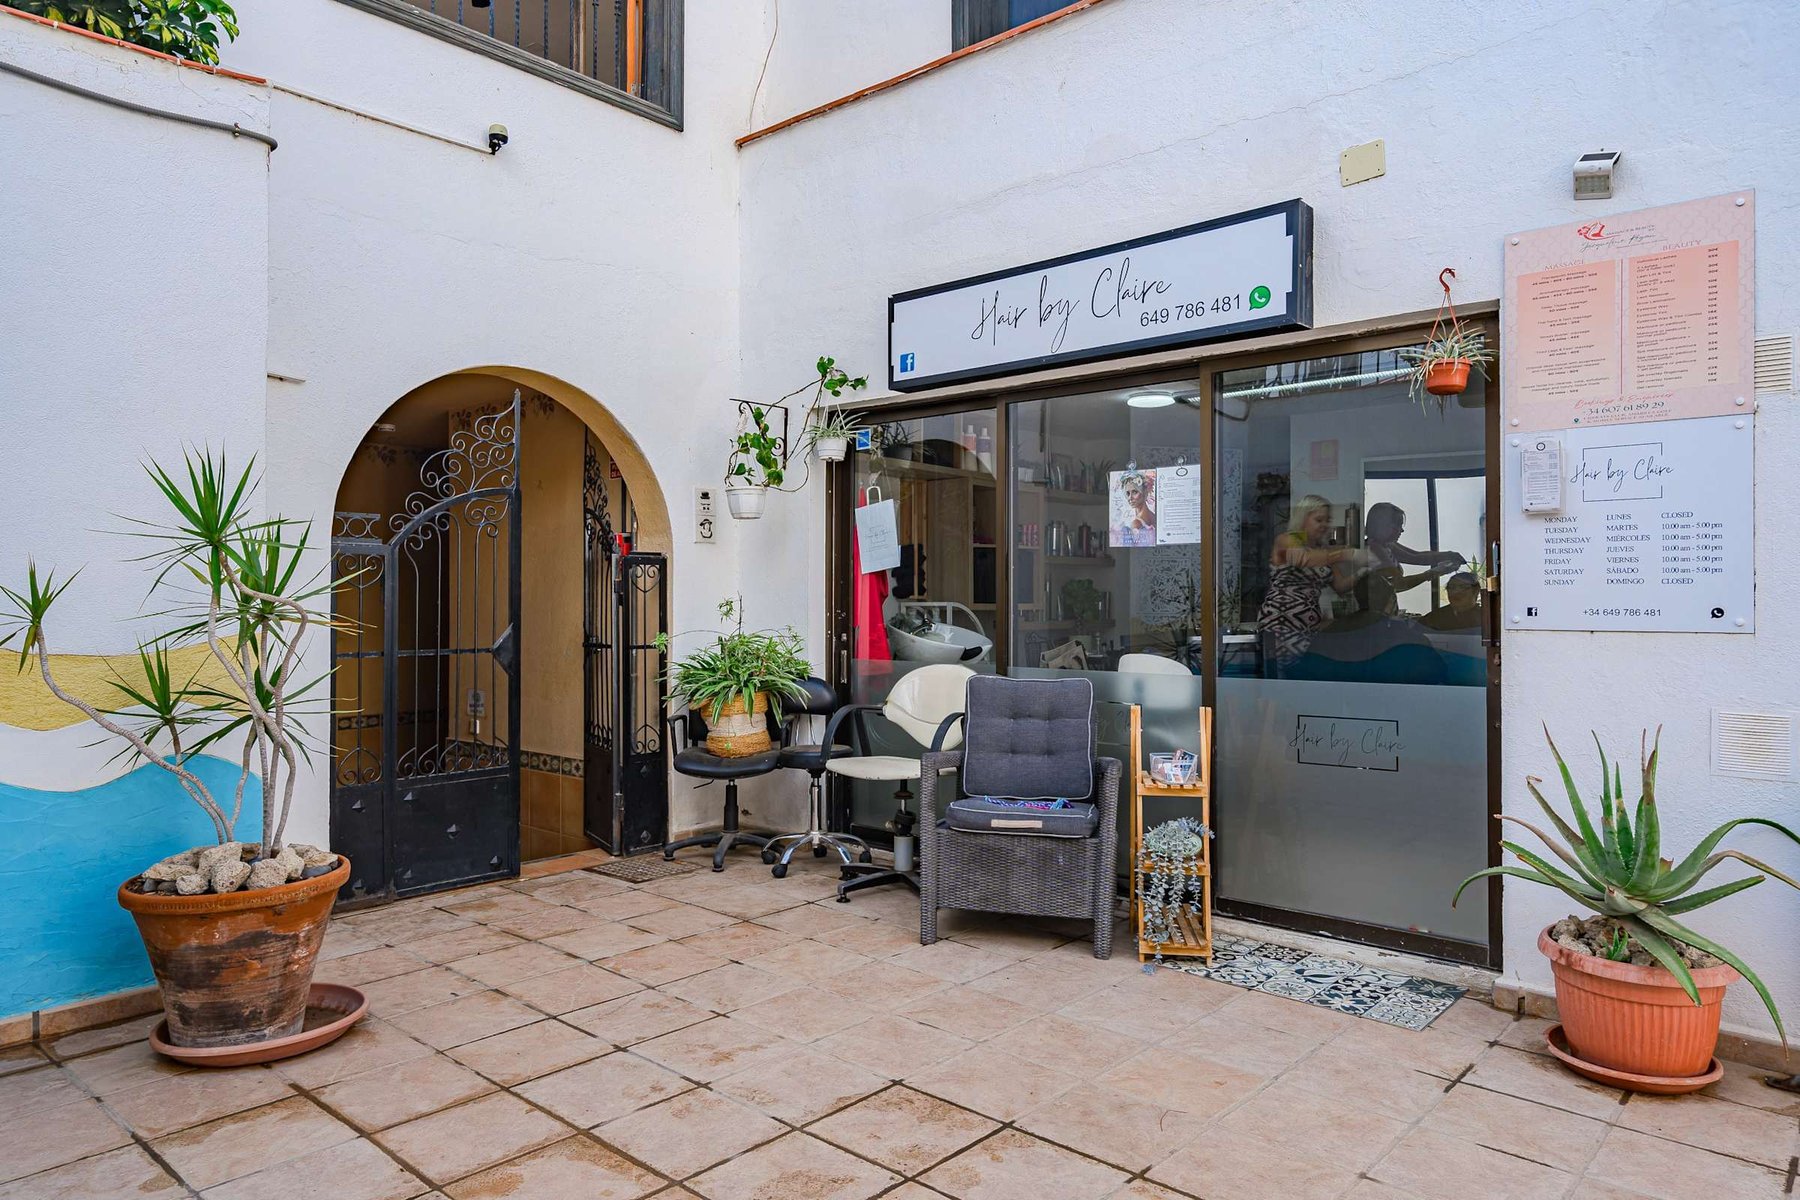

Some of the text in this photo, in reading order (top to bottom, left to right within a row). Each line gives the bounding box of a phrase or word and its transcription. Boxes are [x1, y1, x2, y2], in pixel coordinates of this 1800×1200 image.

[1662, 240, 1701, 251] BEAUTY
[972, 257, 1171, 353] Hair by Claire
[1140, 294, 1241, 327] 649 786 481
[1601, 406, 1622, 414] 607
[1570, 462, 1602, 484] Hair
[1607, 459, 1629, 493] by
[1633, 456, 1674, 481] Claire
[1544, 516, 1577, 524] MONDAY
[1661, 511, 1694, 519] CLOSED
[1544, 547, 1584, 555] THURSDAY
[1583, 608, 1662, 617] +34 649 786 481
[1289, 722, 1406, 767] Hair by Claire
